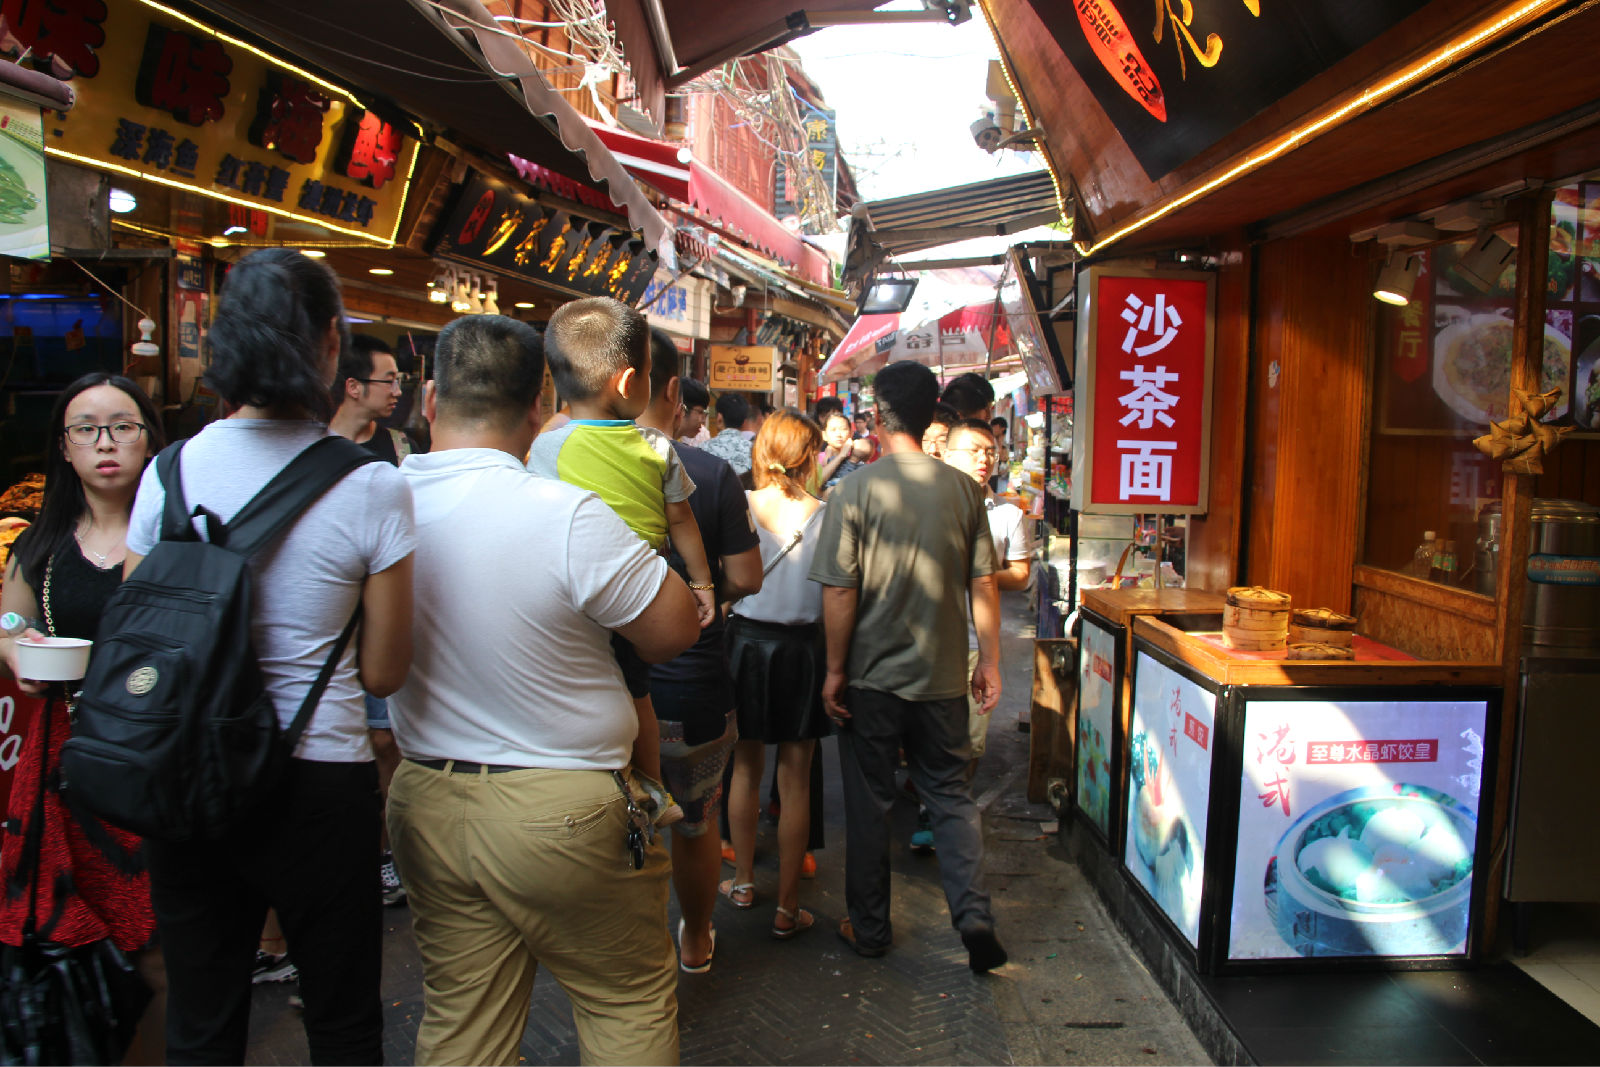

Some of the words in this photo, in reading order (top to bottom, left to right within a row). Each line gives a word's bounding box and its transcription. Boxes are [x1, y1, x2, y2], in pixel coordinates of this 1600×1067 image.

[1117, 293, 1183, 502] 沙茶面
[1257, 723, 1297, 817] 港式
[1311, 742, 1431, 763] 至尊水晶虾饺皇
